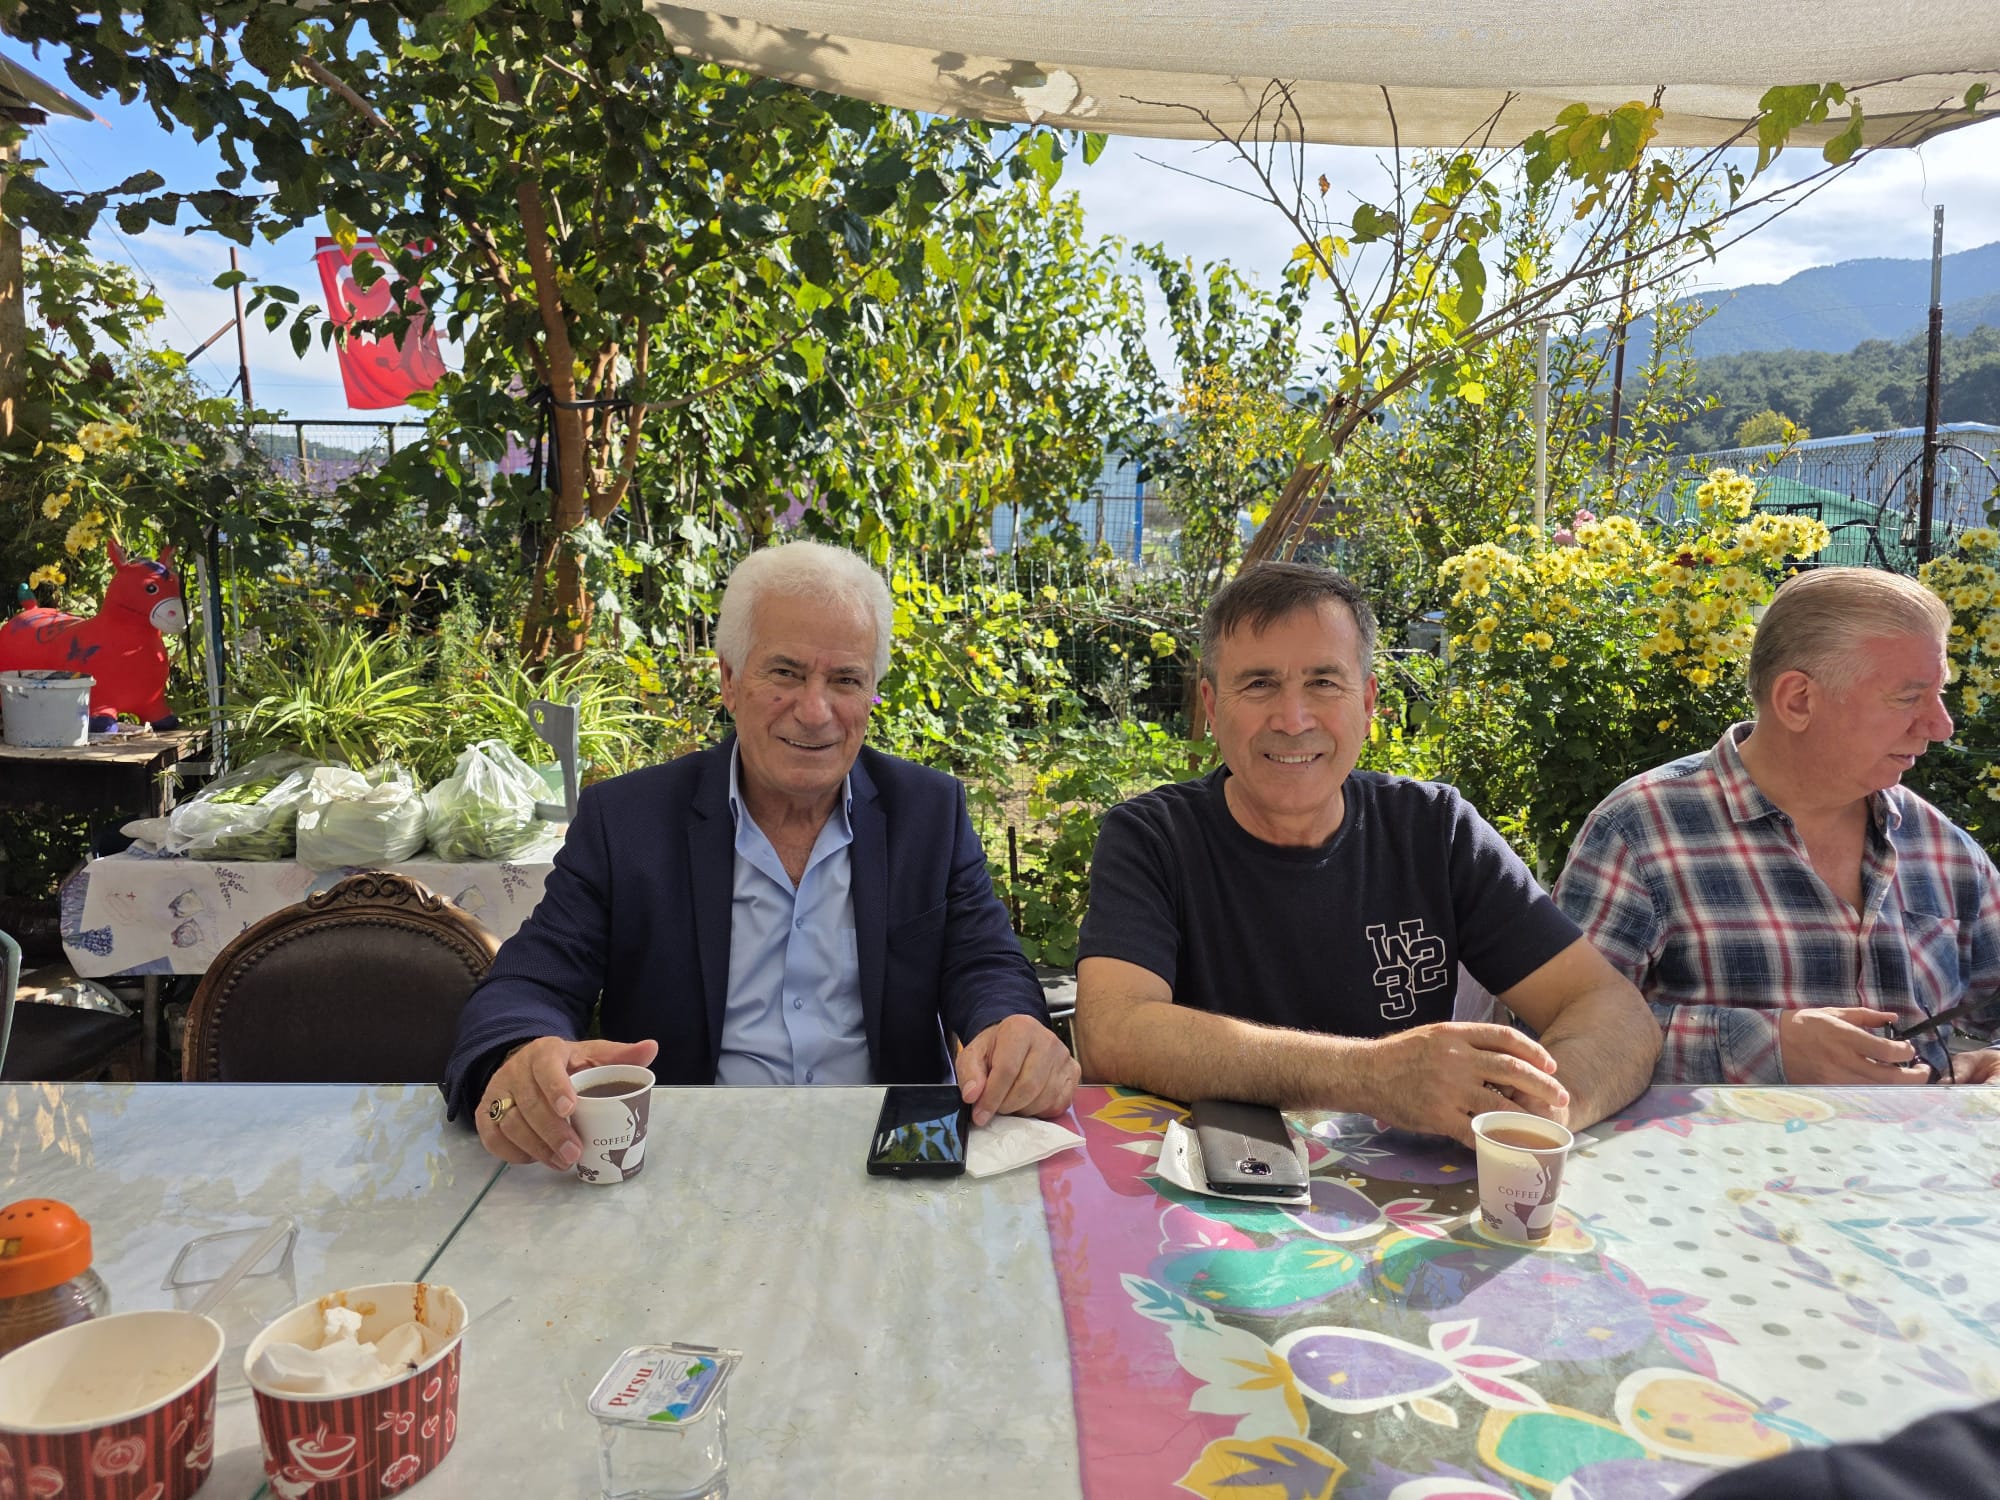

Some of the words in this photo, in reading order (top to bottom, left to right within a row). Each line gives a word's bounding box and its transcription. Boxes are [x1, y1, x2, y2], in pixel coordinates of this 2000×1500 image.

[593, 1134, 631, 1146] COFFEE
[1498, 1185, 1540, 1199] COFFEE
[608, 1367, 653, 1407] Pirsu
